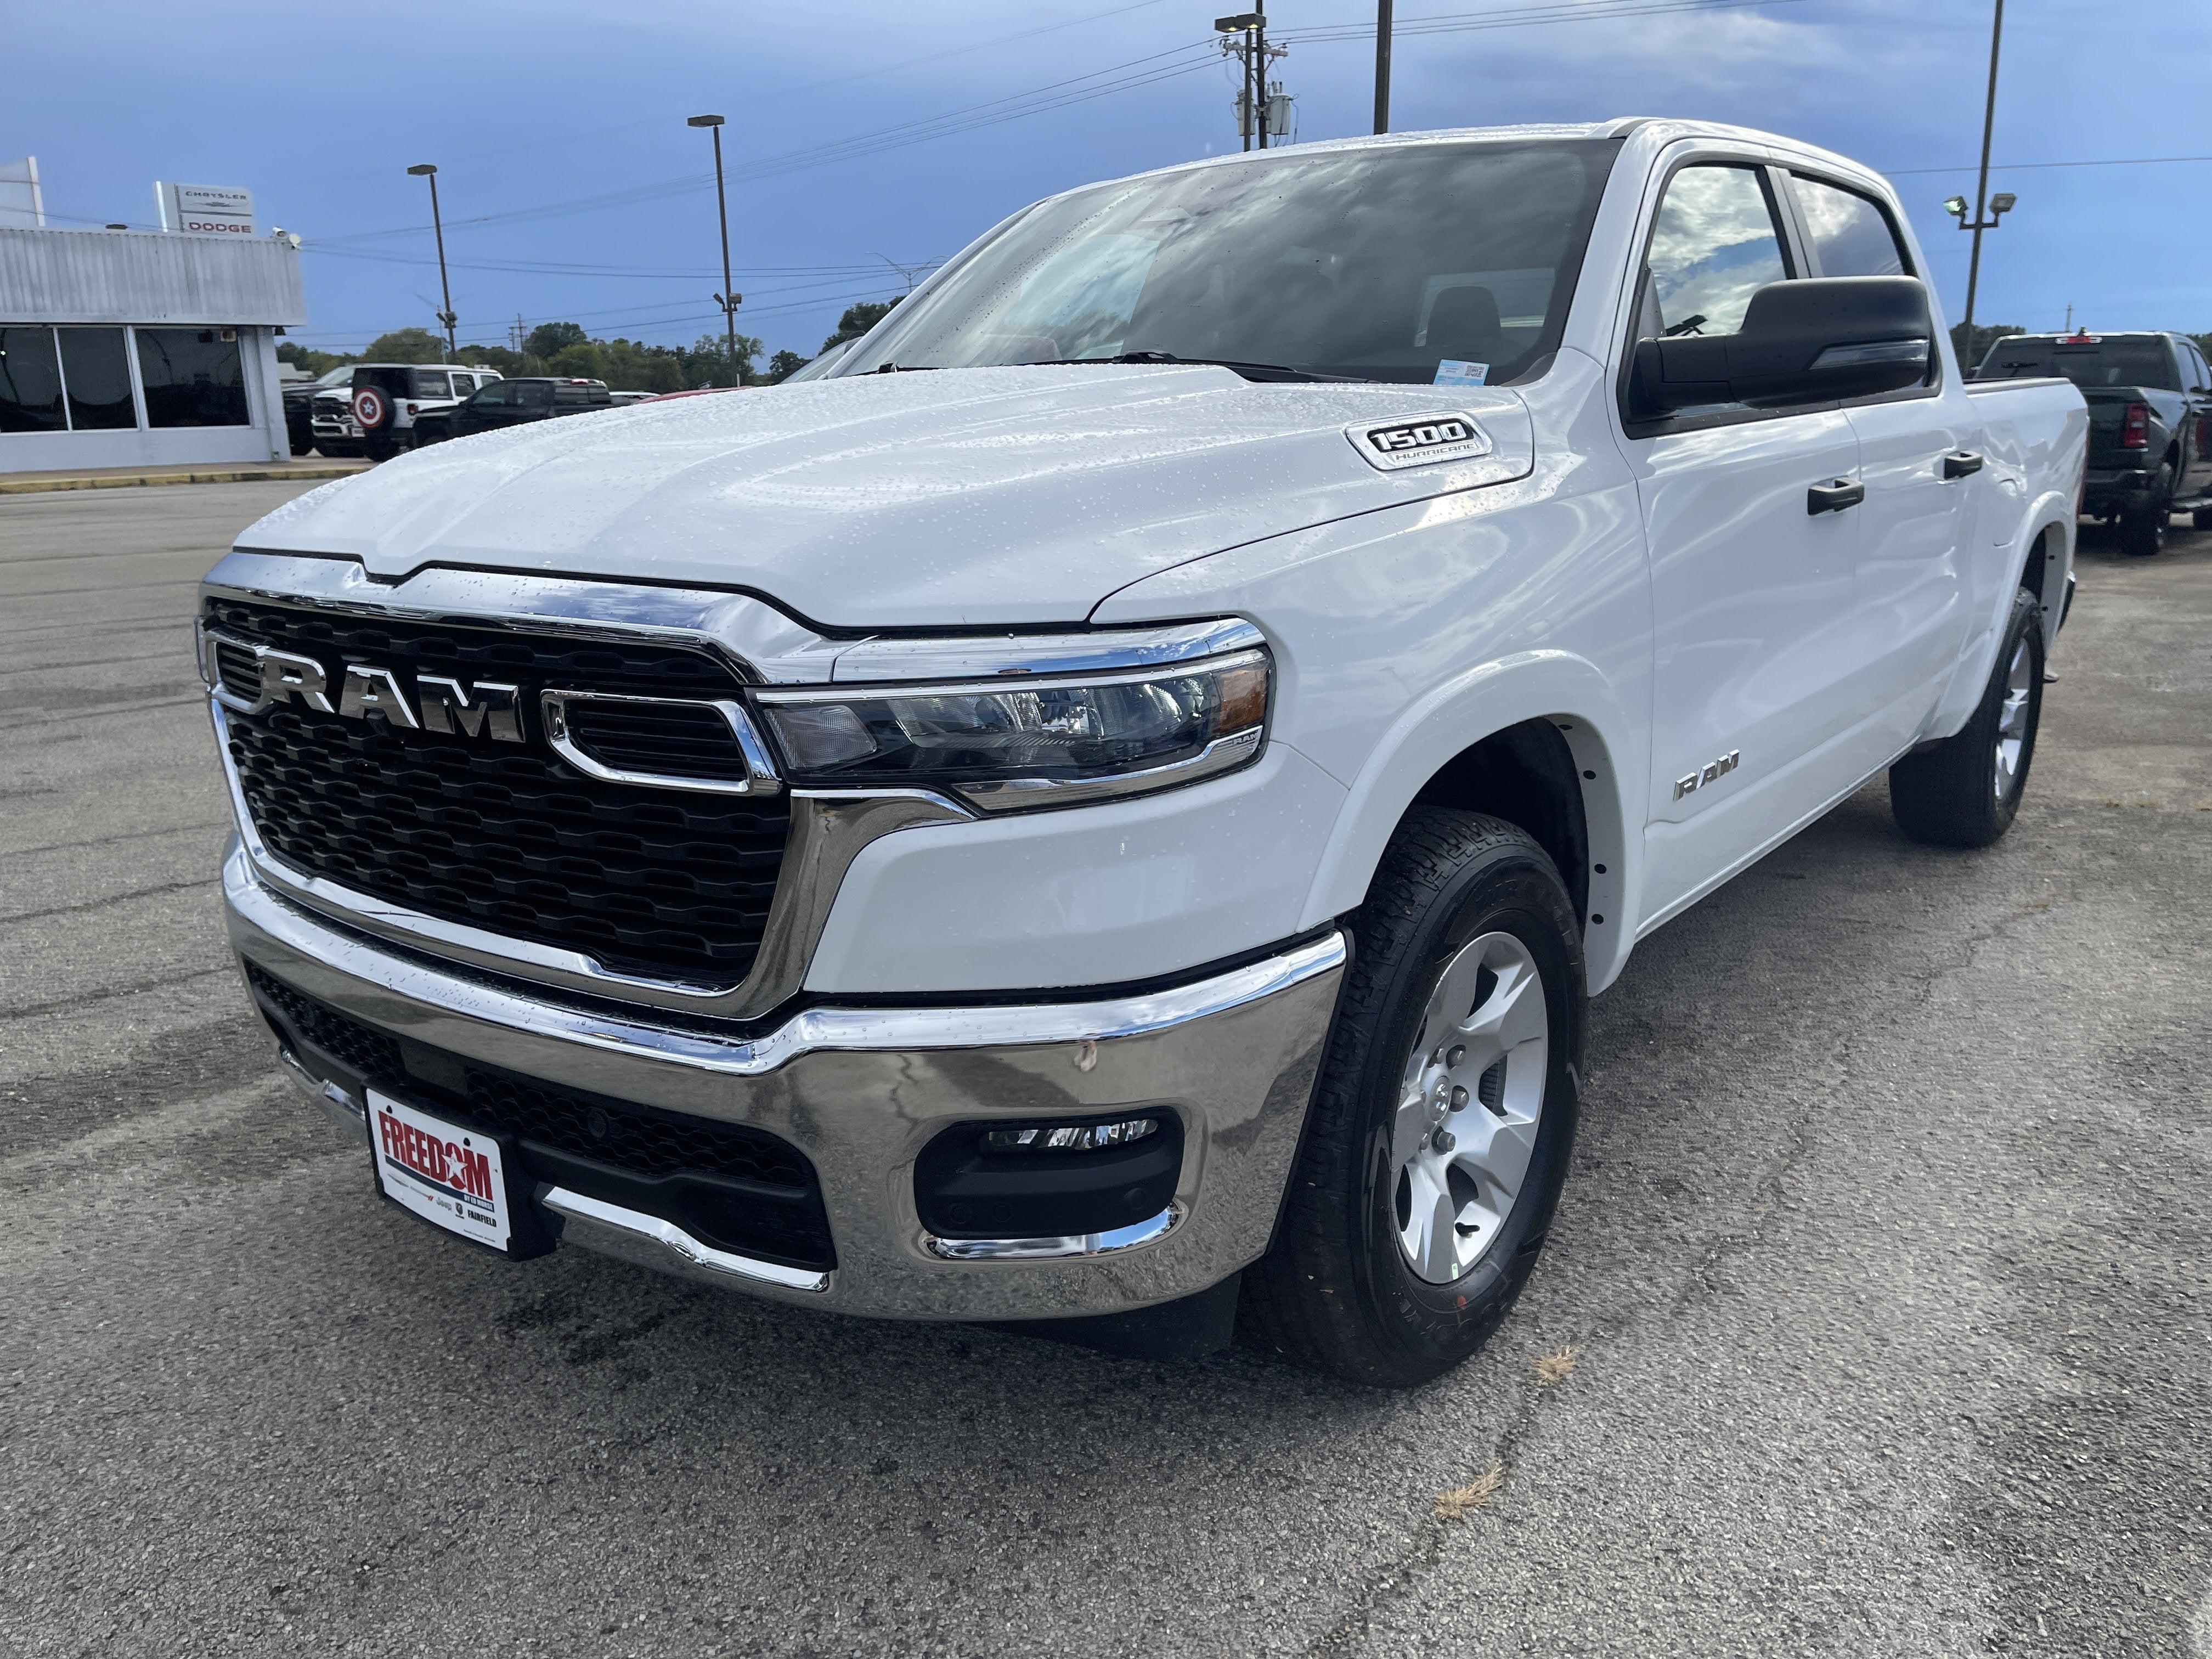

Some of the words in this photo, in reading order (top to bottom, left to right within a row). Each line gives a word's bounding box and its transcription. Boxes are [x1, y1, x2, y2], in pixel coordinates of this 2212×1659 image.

[185, 191, 246, 200] CHRYSLER
[189, 222, 251, 233] DODGE
[1372, 422, 1467, 451] 1500
[1396, 443, 1475, 460] HURRICANE
[260, 647, 526, 743] RAM
[1673, 749, 1739, 802] RAM
[377, 1110, 493, 1201] FREEDOM
[467, 1209, 496, 1227] FAIRFIELD
